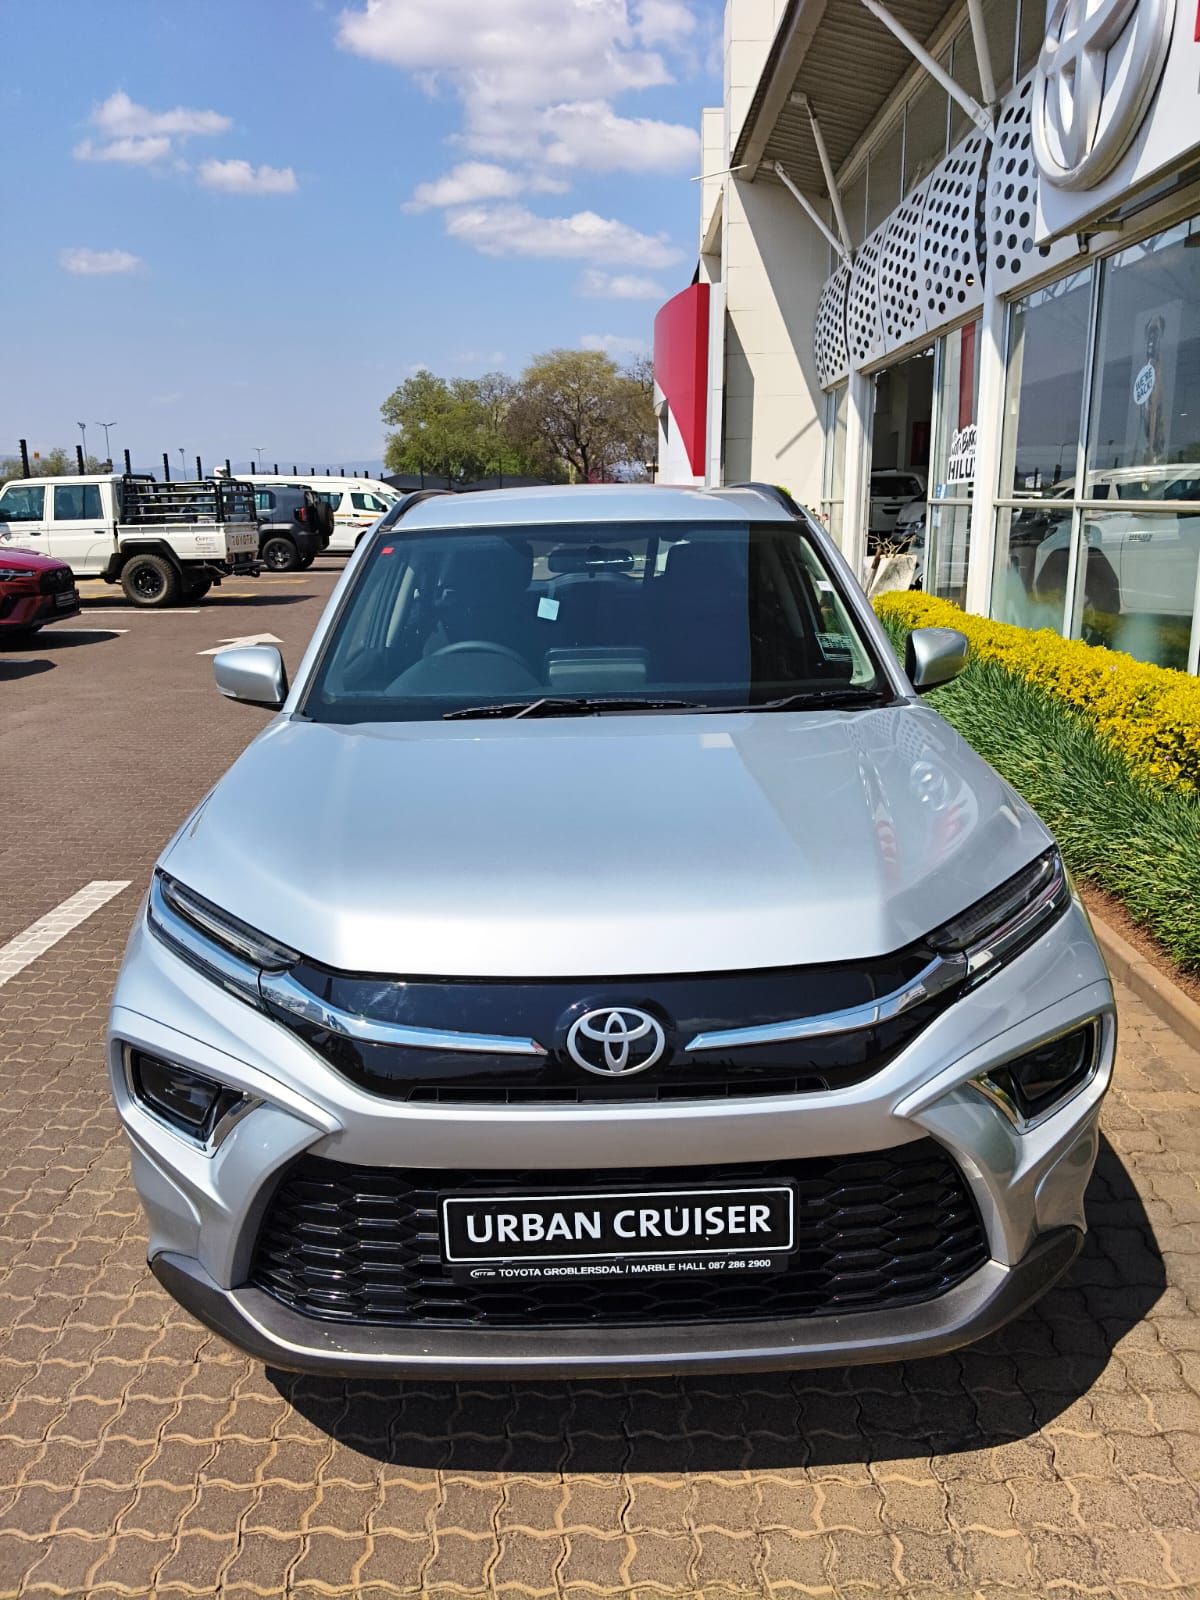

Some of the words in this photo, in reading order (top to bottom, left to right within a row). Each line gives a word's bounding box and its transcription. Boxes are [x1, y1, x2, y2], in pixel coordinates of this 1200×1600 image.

[1135, 367, 1153, 391] WE'RE
[466, 1211, 601, 1243] URBAN
[613, 1204, 772, 1238] CRUISER
[498, 1268, 542, 1277] TOYOTA
[543, 1265, 624, 1276] GROBLERSDAL
[631, 1263, 676, 1273] MARBLE
[678, 1262, 706, 1271] HALL
[708, 1261, 726, 1270] 087
[727, 1260, 746, 1269] 286
[747, 1259, 771, 1269] 2900
